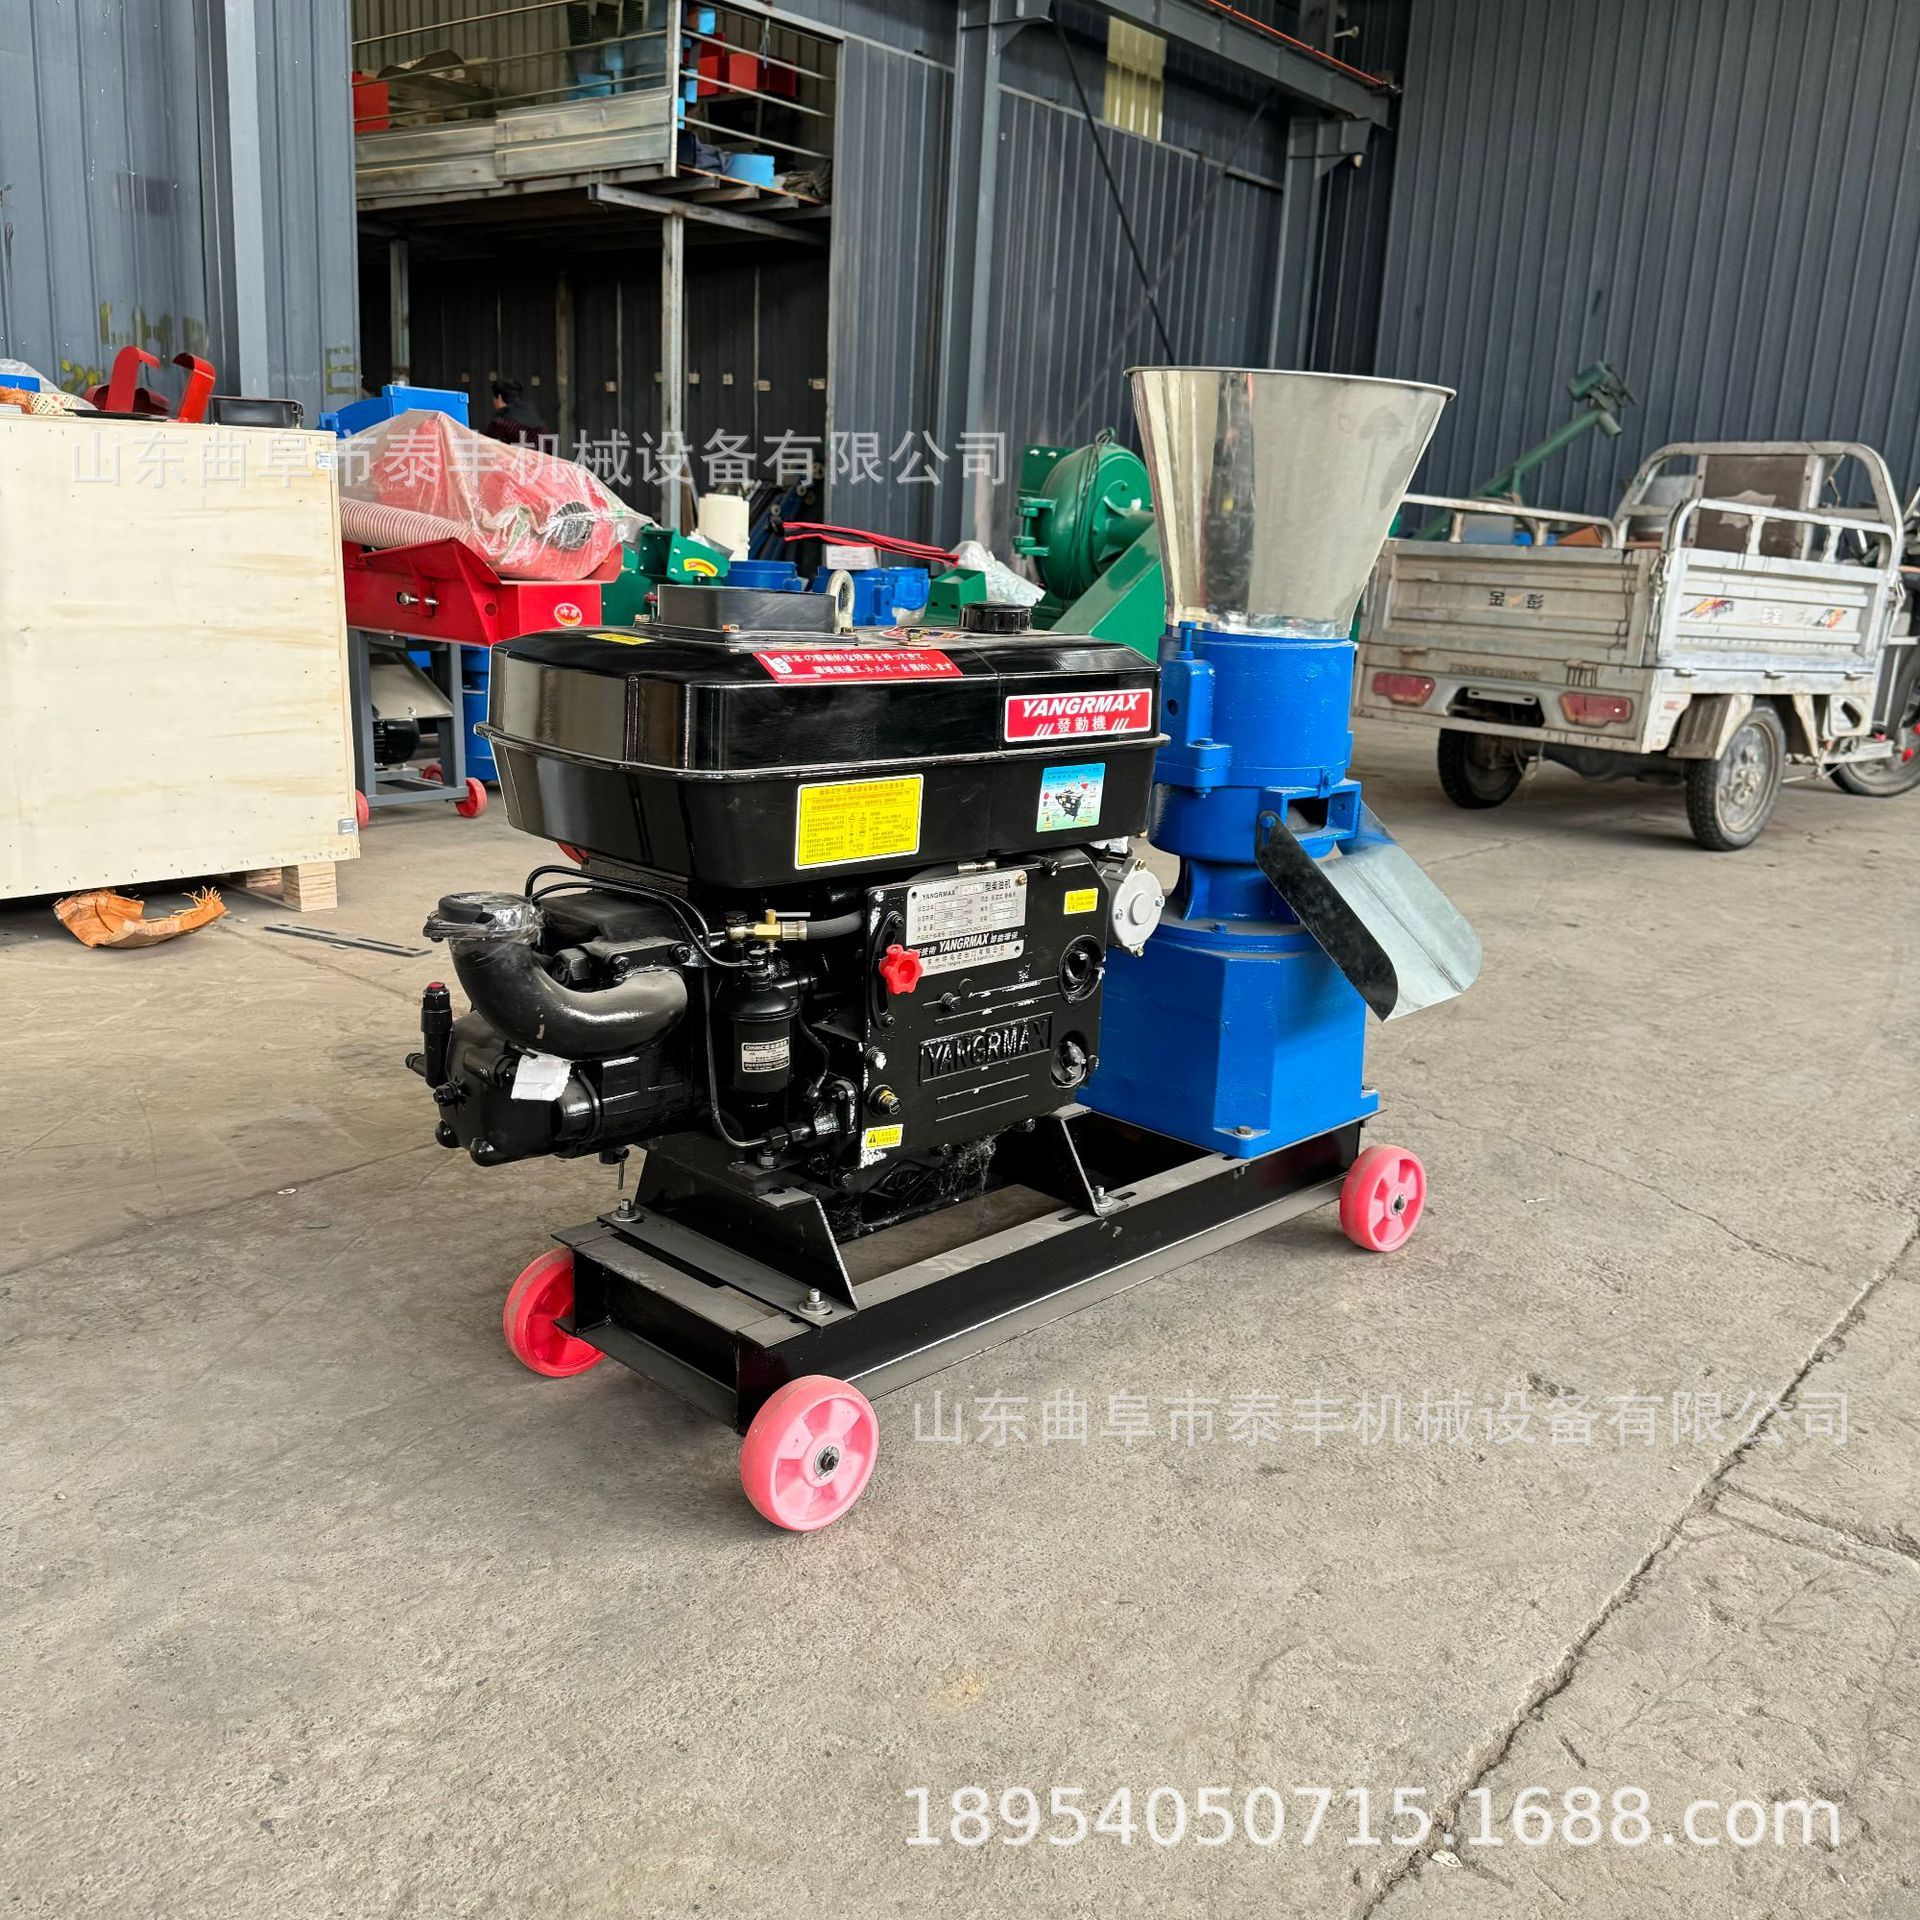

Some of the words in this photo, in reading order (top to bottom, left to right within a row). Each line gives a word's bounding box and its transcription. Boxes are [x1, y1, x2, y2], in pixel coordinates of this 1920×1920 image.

[1023, 694, 1140, 717] YANGRMAX
[1057, 716, 1107, 734] 發動機
[940, 933, 989, 953] YANGRMAX
[920, 1020, 1048, 1077] YANGRMAX
